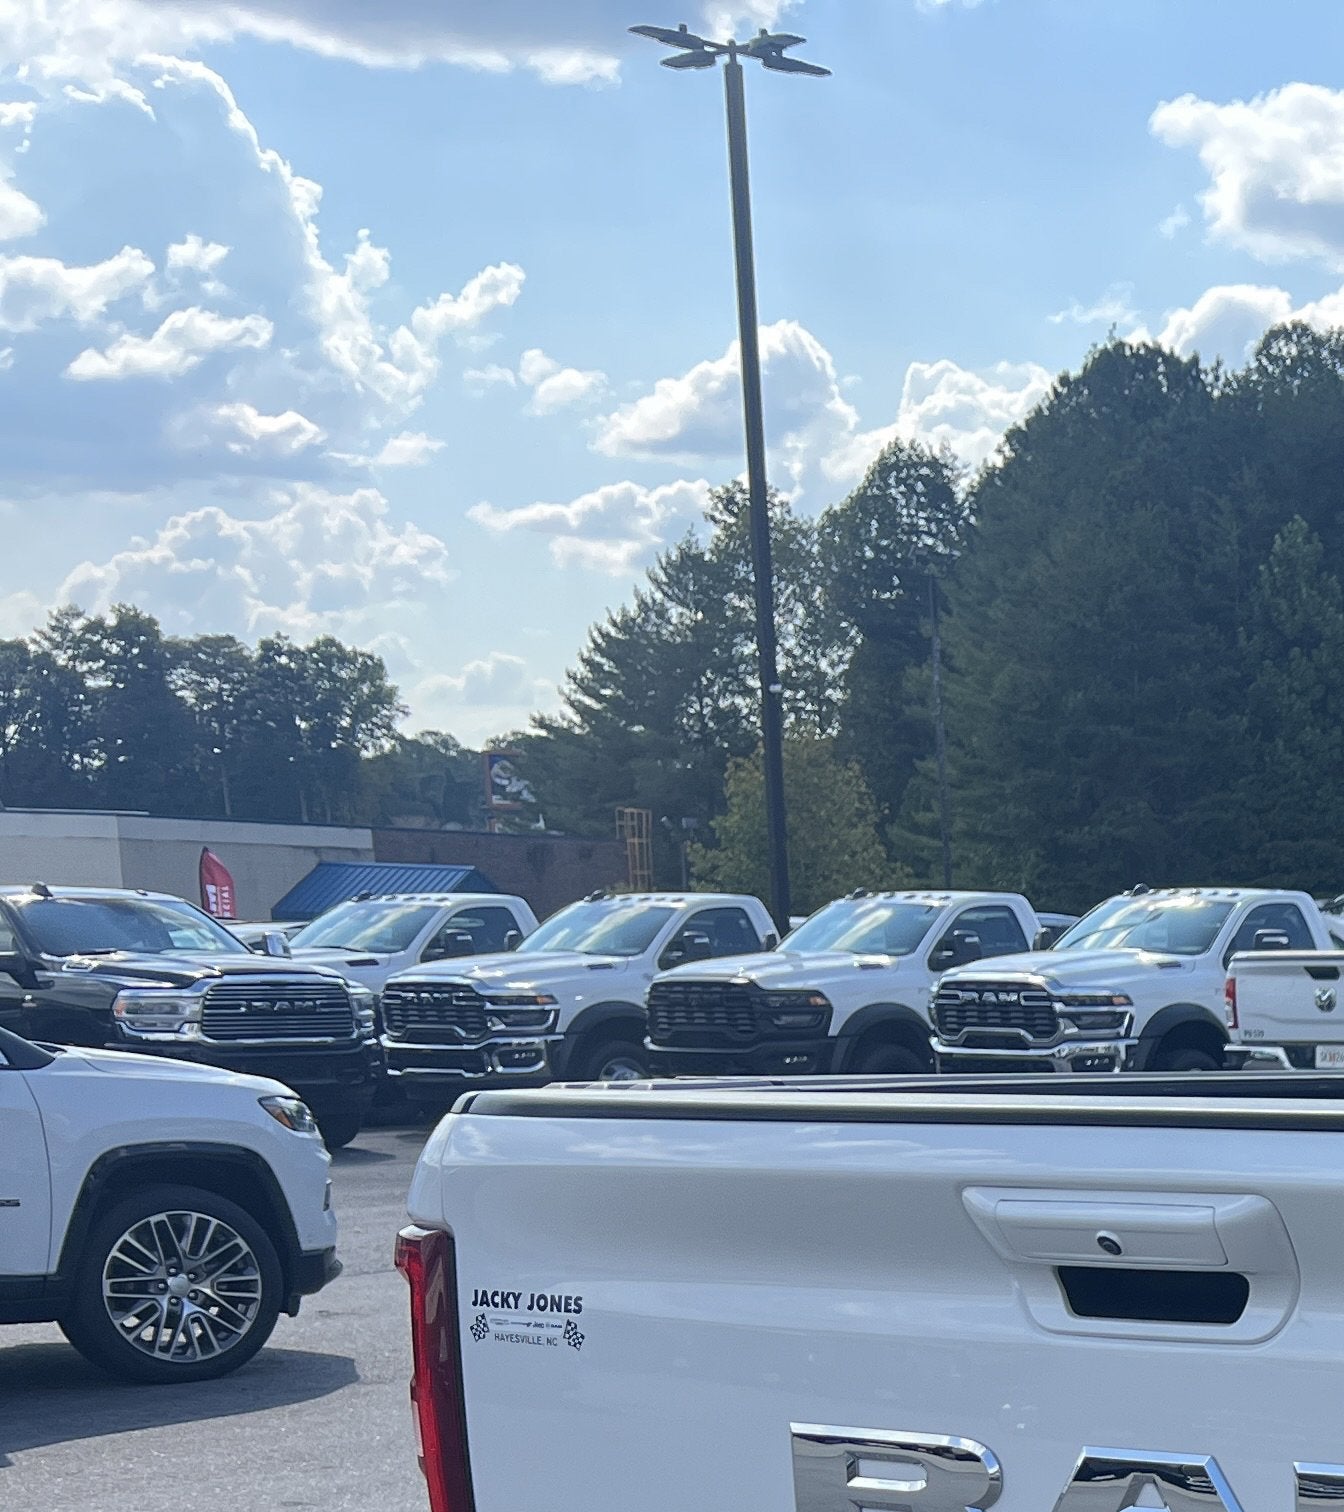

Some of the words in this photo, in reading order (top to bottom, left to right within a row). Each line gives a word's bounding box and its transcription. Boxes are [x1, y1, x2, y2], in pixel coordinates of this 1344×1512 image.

[471, 1289, 522, 1310] JACKY
[527, 1293, 583, 1315] JONES
[546, 1336, 558, 1347] NC
